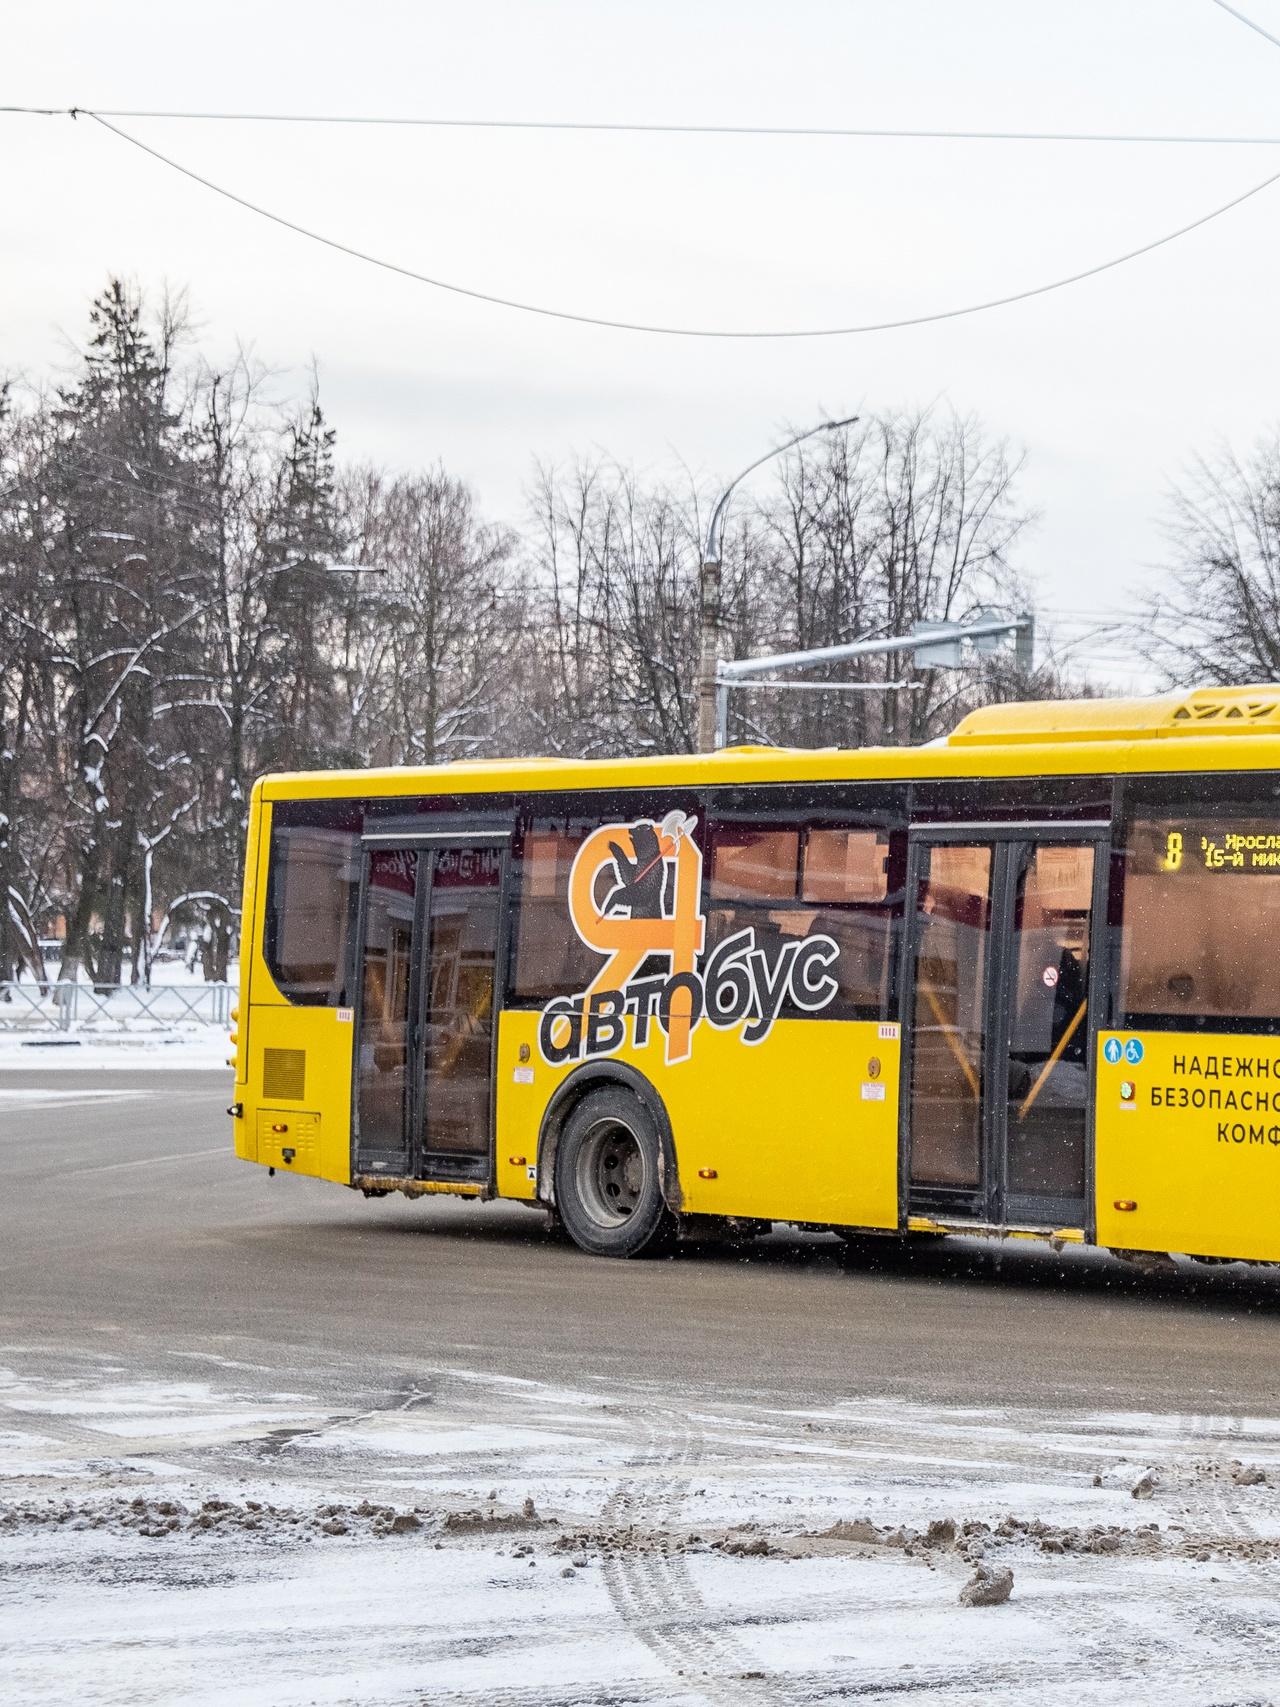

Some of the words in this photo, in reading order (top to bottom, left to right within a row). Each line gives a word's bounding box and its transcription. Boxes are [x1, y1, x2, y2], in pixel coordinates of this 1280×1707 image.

[1167, 832, 1183, 870] 8
[1205, 849, 1244, 867] 15-й
[568, 820, 706, 1066] Я
[537, 925, 841, 1068] автобус
